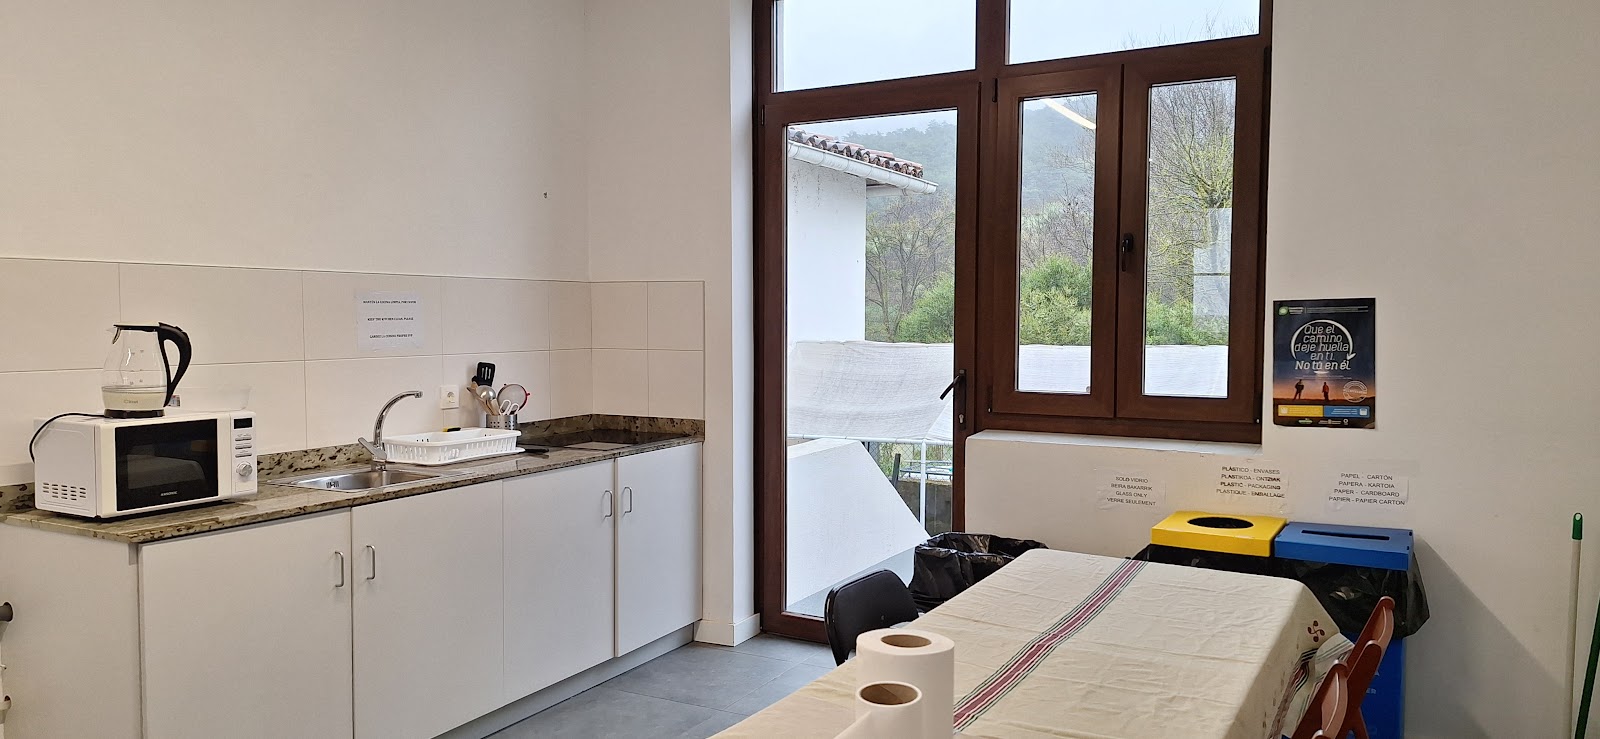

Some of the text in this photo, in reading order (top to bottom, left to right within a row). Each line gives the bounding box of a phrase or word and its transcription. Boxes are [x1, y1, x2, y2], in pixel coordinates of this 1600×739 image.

[1304, 325, 1335, 334] Que el
[1294, 342, 1349, 353] deje huella
[1295, 361, 1310, 370] No
[1325, 362, 1338, 370] en
